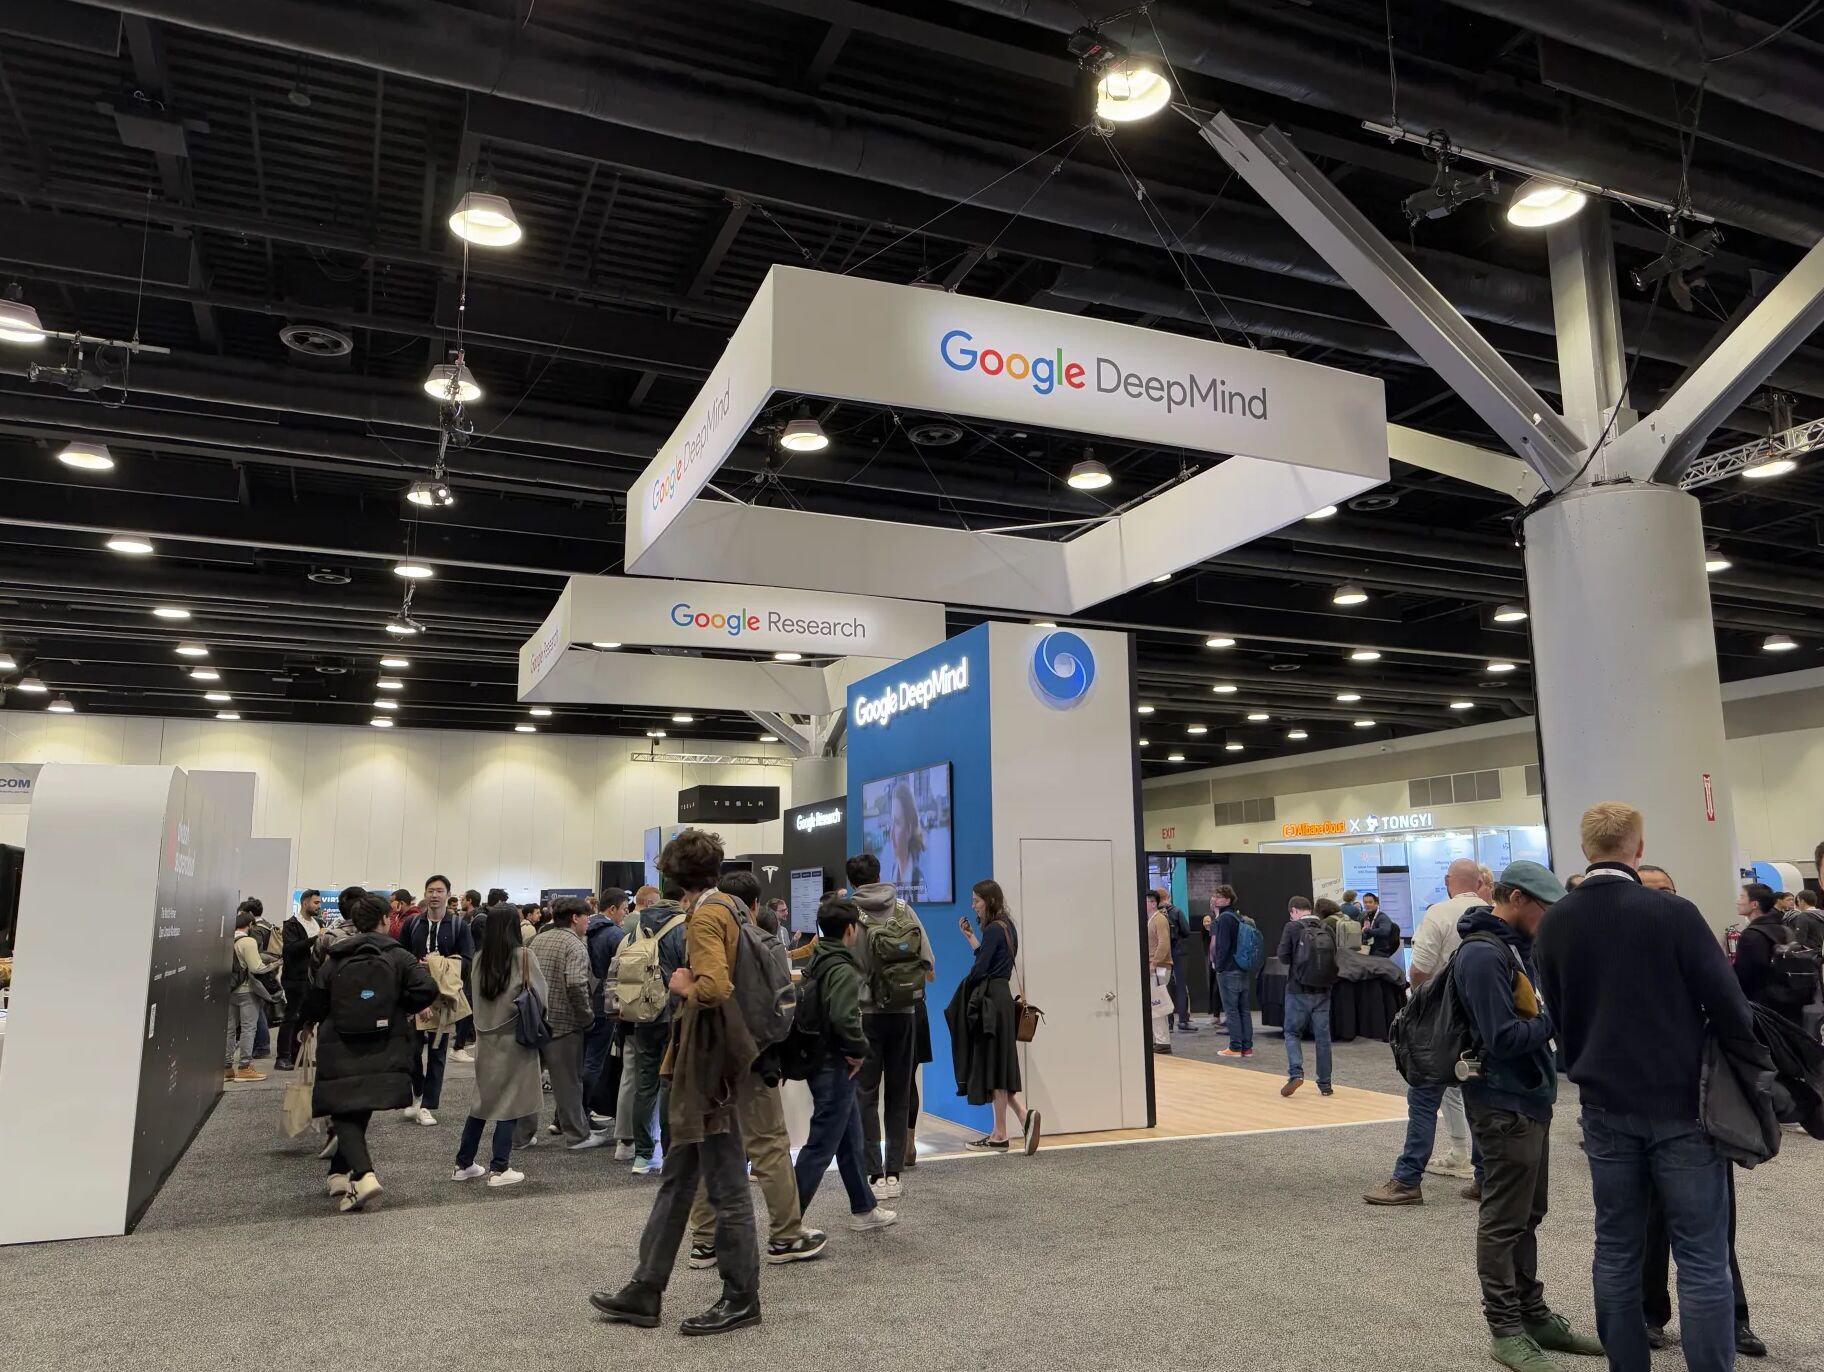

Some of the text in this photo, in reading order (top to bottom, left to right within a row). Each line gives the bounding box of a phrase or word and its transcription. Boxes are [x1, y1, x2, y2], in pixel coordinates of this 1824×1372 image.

[940, 329, 1268, 420] Google DeepMind
[652, 375, 731, 511] Google DeepMind
[670, 602, 866, 638] Google Research
[855, 656, 968, 726] Google DeepMind
[796, 807, 841, 832] Google Research
[1162, 828, 1175, 839] EXIT
[1297, 823, 1324, 836] Alibaba
[1324, 821, 1345, 834] Cloud
[1382, 813, 1432, 830] TONGYI
